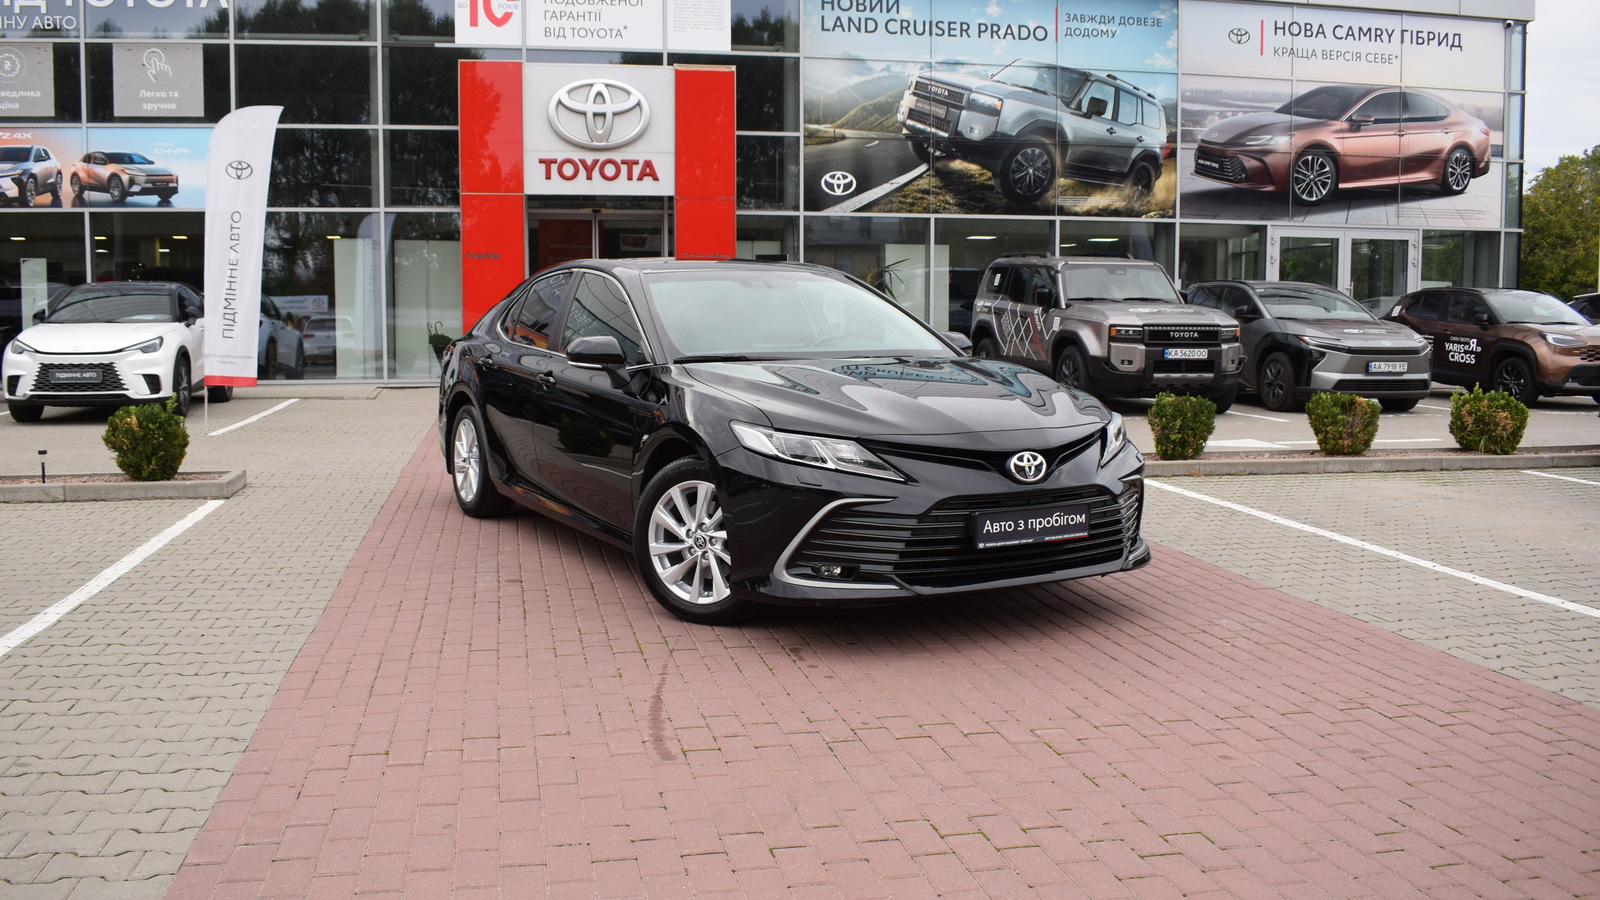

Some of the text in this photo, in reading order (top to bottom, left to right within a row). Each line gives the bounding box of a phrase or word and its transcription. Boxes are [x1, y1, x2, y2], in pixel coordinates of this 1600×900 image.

[544, 9, 602, 22] ГАРАНТІЇ
[1064, 13, 1163, 28] ЗАВЖДИ ДОВЕЗЕ
[31, 15, 77, 30] АВТО
[820, 16, 1049, 42] LAND CRUISER PRADO
[544, 27, 566, 40] ВІД
[1064, 27, 1118, 39] ДОДОМУ
[1273, 20, 1463, 51] НОВА CAMRY ГІБРИД
[1273, 46, 1318, 60] КРАЩА
[1321, 50, 1362, 63] ВЕРСІЯ
[138, 89, 167, 98] Легко
[928, 85, 949, 96] TOYOTA
[142, 101, 177, 111] зручно
[0, 131, 32, 140] Z4X
[538, 157, 660, 182] TOYOTA
[222, 210, 242, 339] ПІДМІННЕ АВТО
[1179, 349, 1196, 357] 5620
[1445, 342, 1465, 353] YARIS
[1449, 351, 1476, 364] CROSS
[1383, 363, 1397, 371] 7918
[982, 512, 1086, 534] Авто з пробігом
